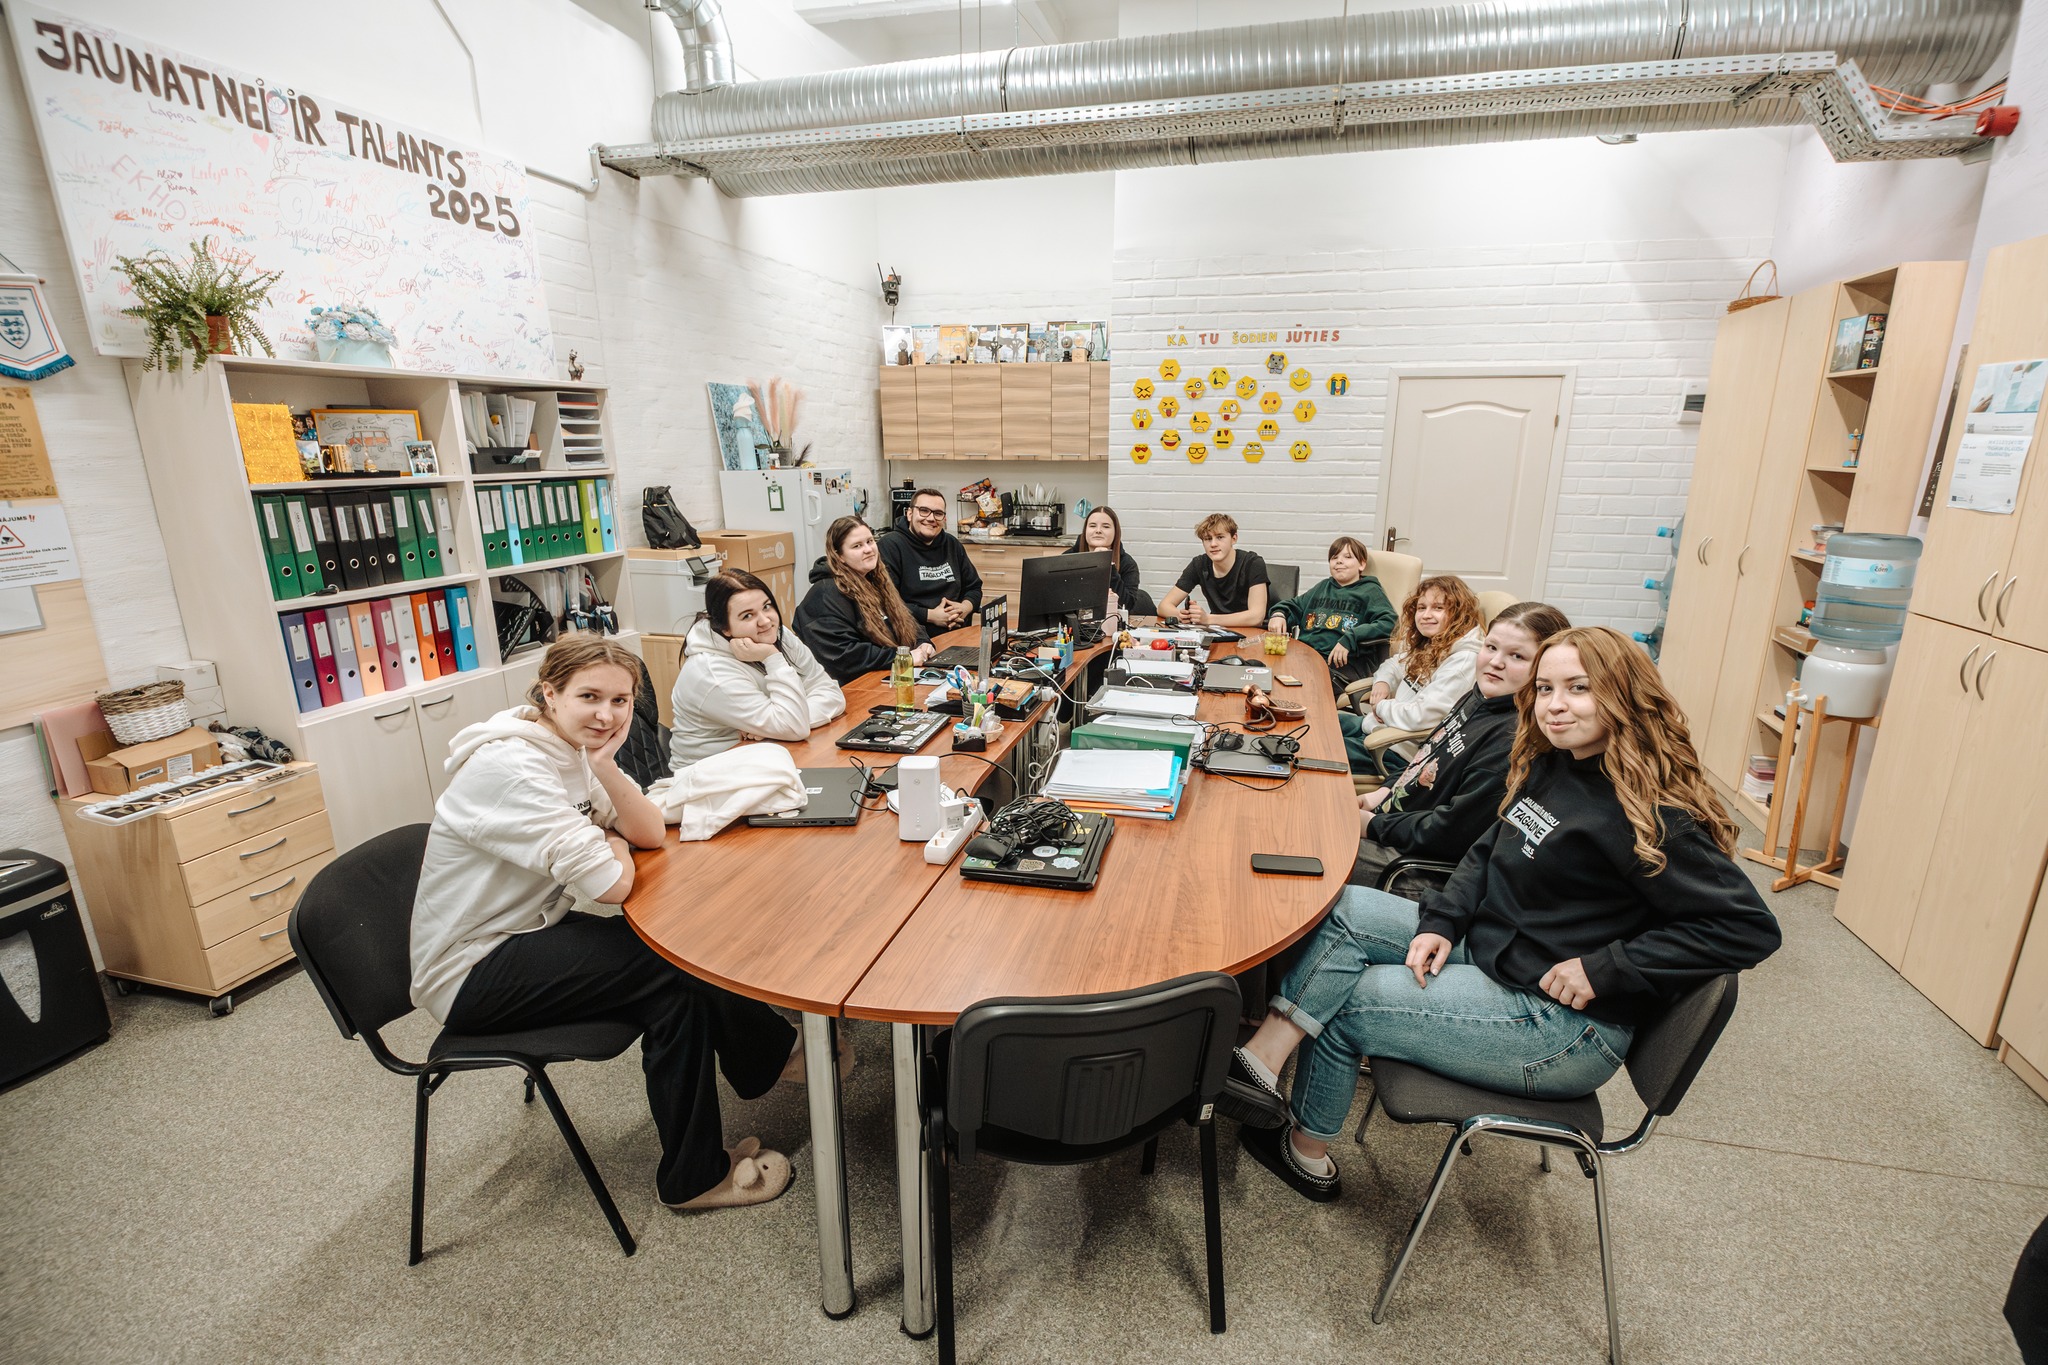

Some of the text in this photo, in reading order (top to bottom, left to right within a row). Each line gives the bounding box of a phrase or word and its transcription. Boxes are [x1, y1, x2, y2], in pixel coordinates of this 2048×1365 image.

[336, 110, 467, 188] TALANTS
[427, 183, 520, 237] 2025
[1167, 324, 1340, 346] KĀ TU ŠODIEN JŪTIES
[921, 568, 951, 579] TAGADNE
[1512, 807, 1546, 839] TAGADNE
